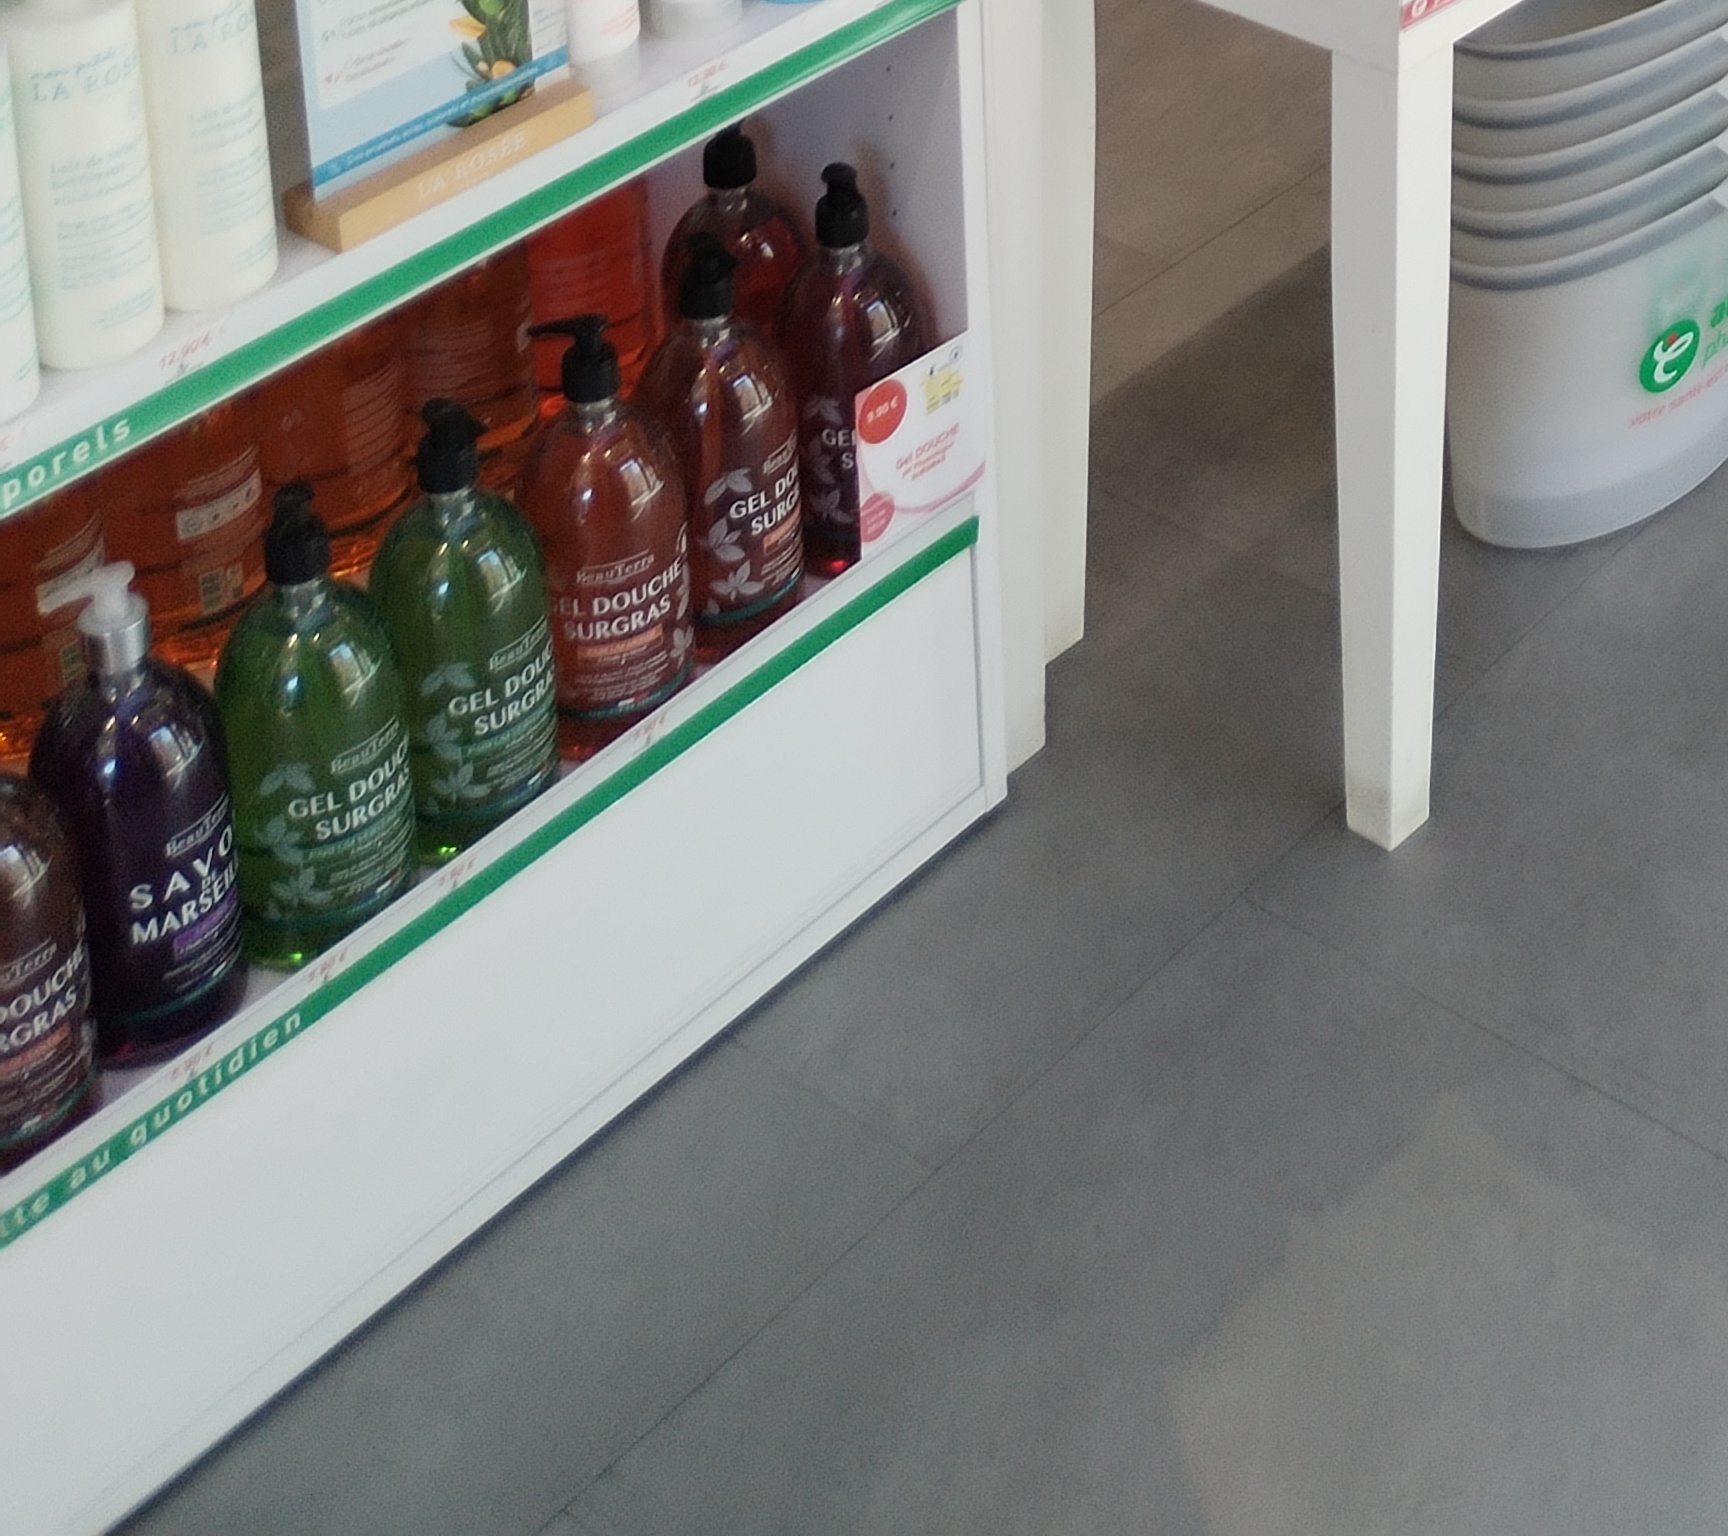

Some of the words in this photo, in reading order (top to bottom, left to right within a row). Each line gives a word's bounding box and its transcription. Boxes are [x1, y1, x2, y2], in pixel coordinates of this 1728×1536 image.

[2, 418, 131, 505] porels
[729, 492, 770, 520] GEL
[448, 690, 498, 716] GEL
[288, 793, 341, 820] GEL
[130, 825, 232, 910] SAVO
[15, 1191, 50, 1230] te
[69, 1148, 110, 1191] au
[129, 1011, 303, 1149] quotidien
